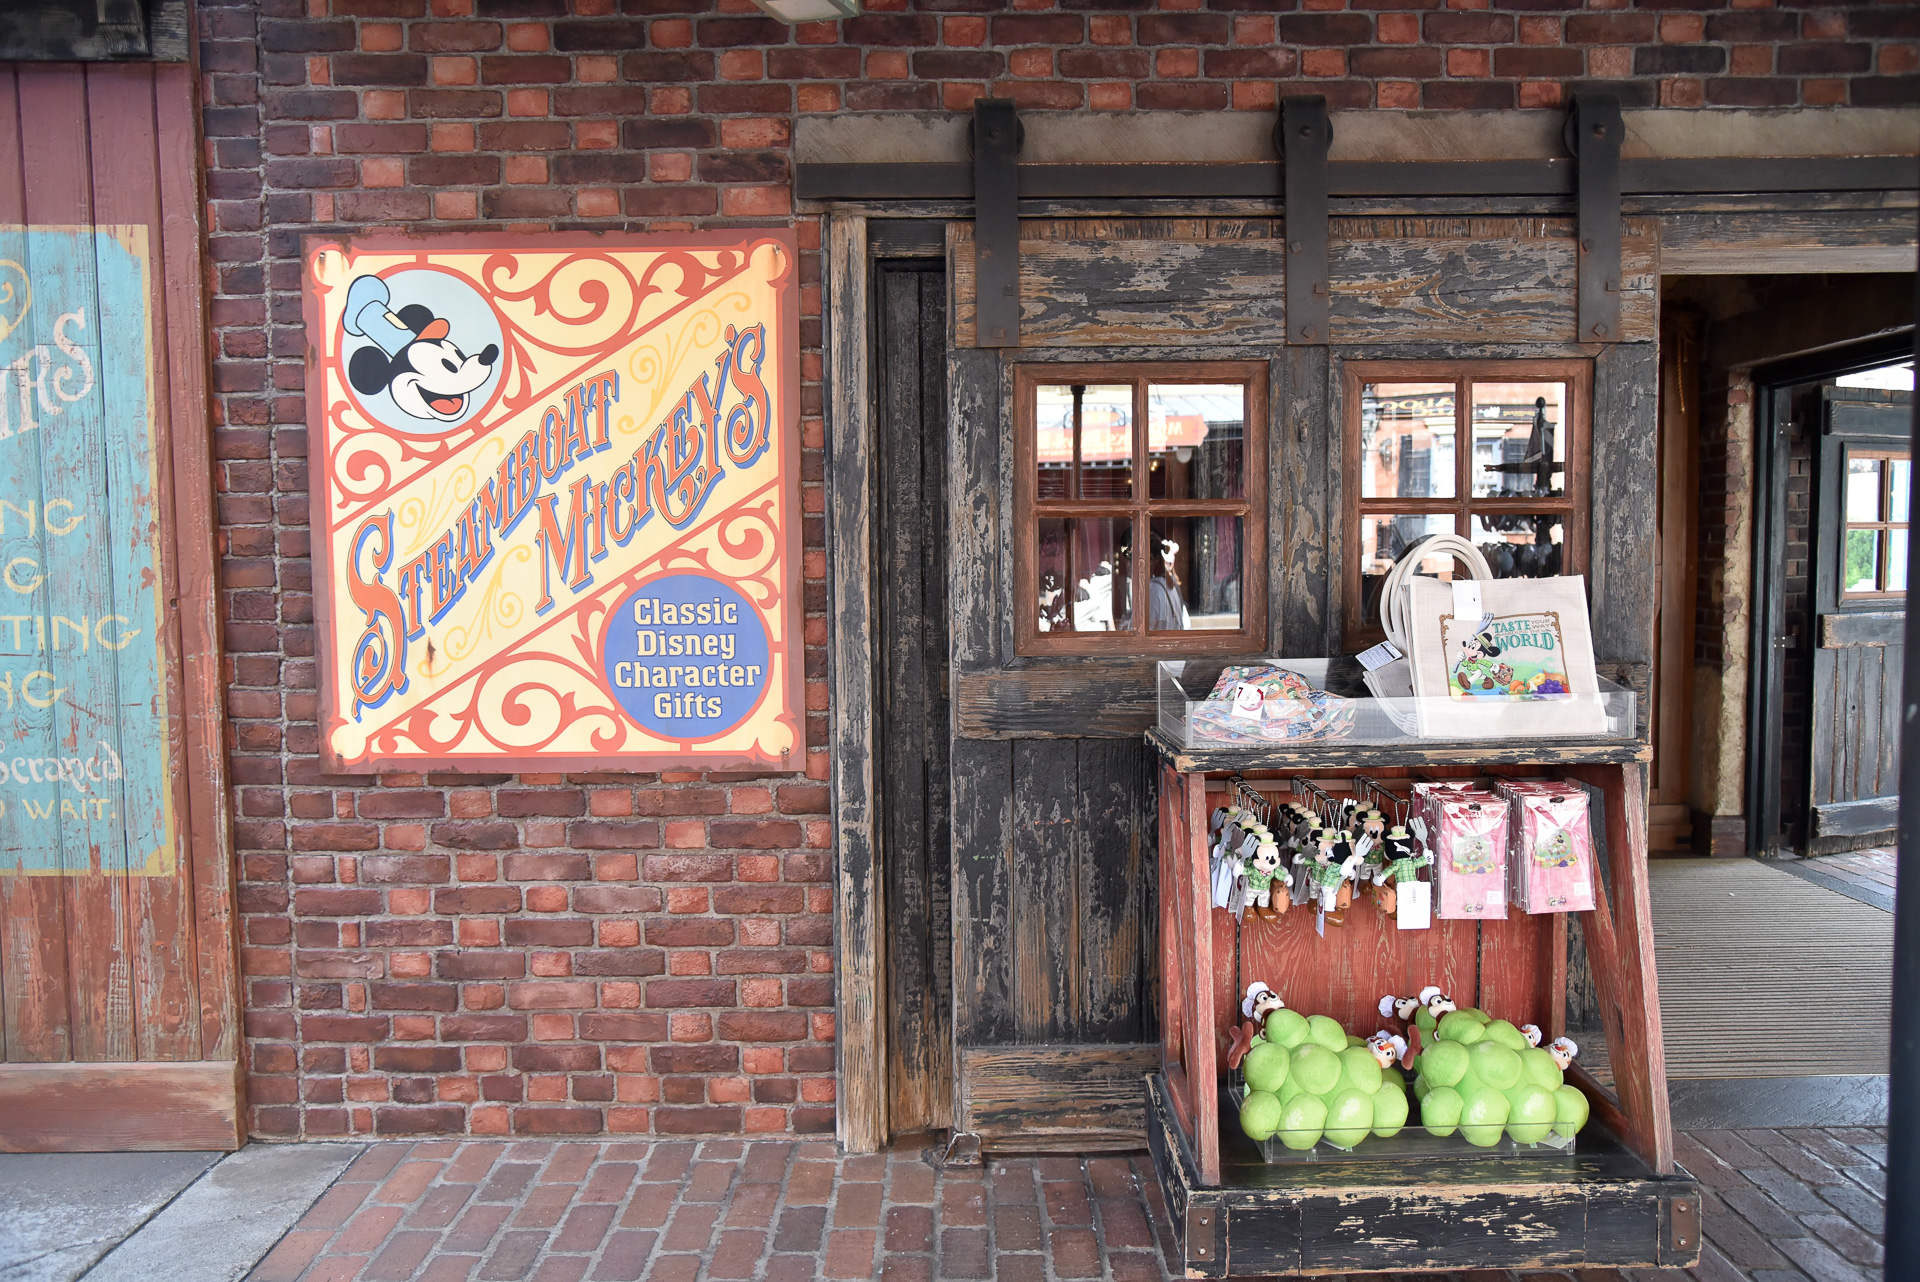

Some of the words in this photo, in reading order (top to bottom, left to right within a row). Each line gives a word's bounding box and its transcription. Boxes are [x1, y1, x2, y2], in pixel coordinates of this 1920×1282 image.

[535, 322, 770, 616] MICKEY'S
[347, 368, 620, 722] STEAMBOAT
[633, 597, 739, 626] Classic
[1491, 620, 1531, 633] TASTE
[636, 630, 736, 660] Disney
[1493, 632, 1554, 653] WORLD
[614, 661, 762, 688] Character
[653, 692, 723, 719] Gifts
